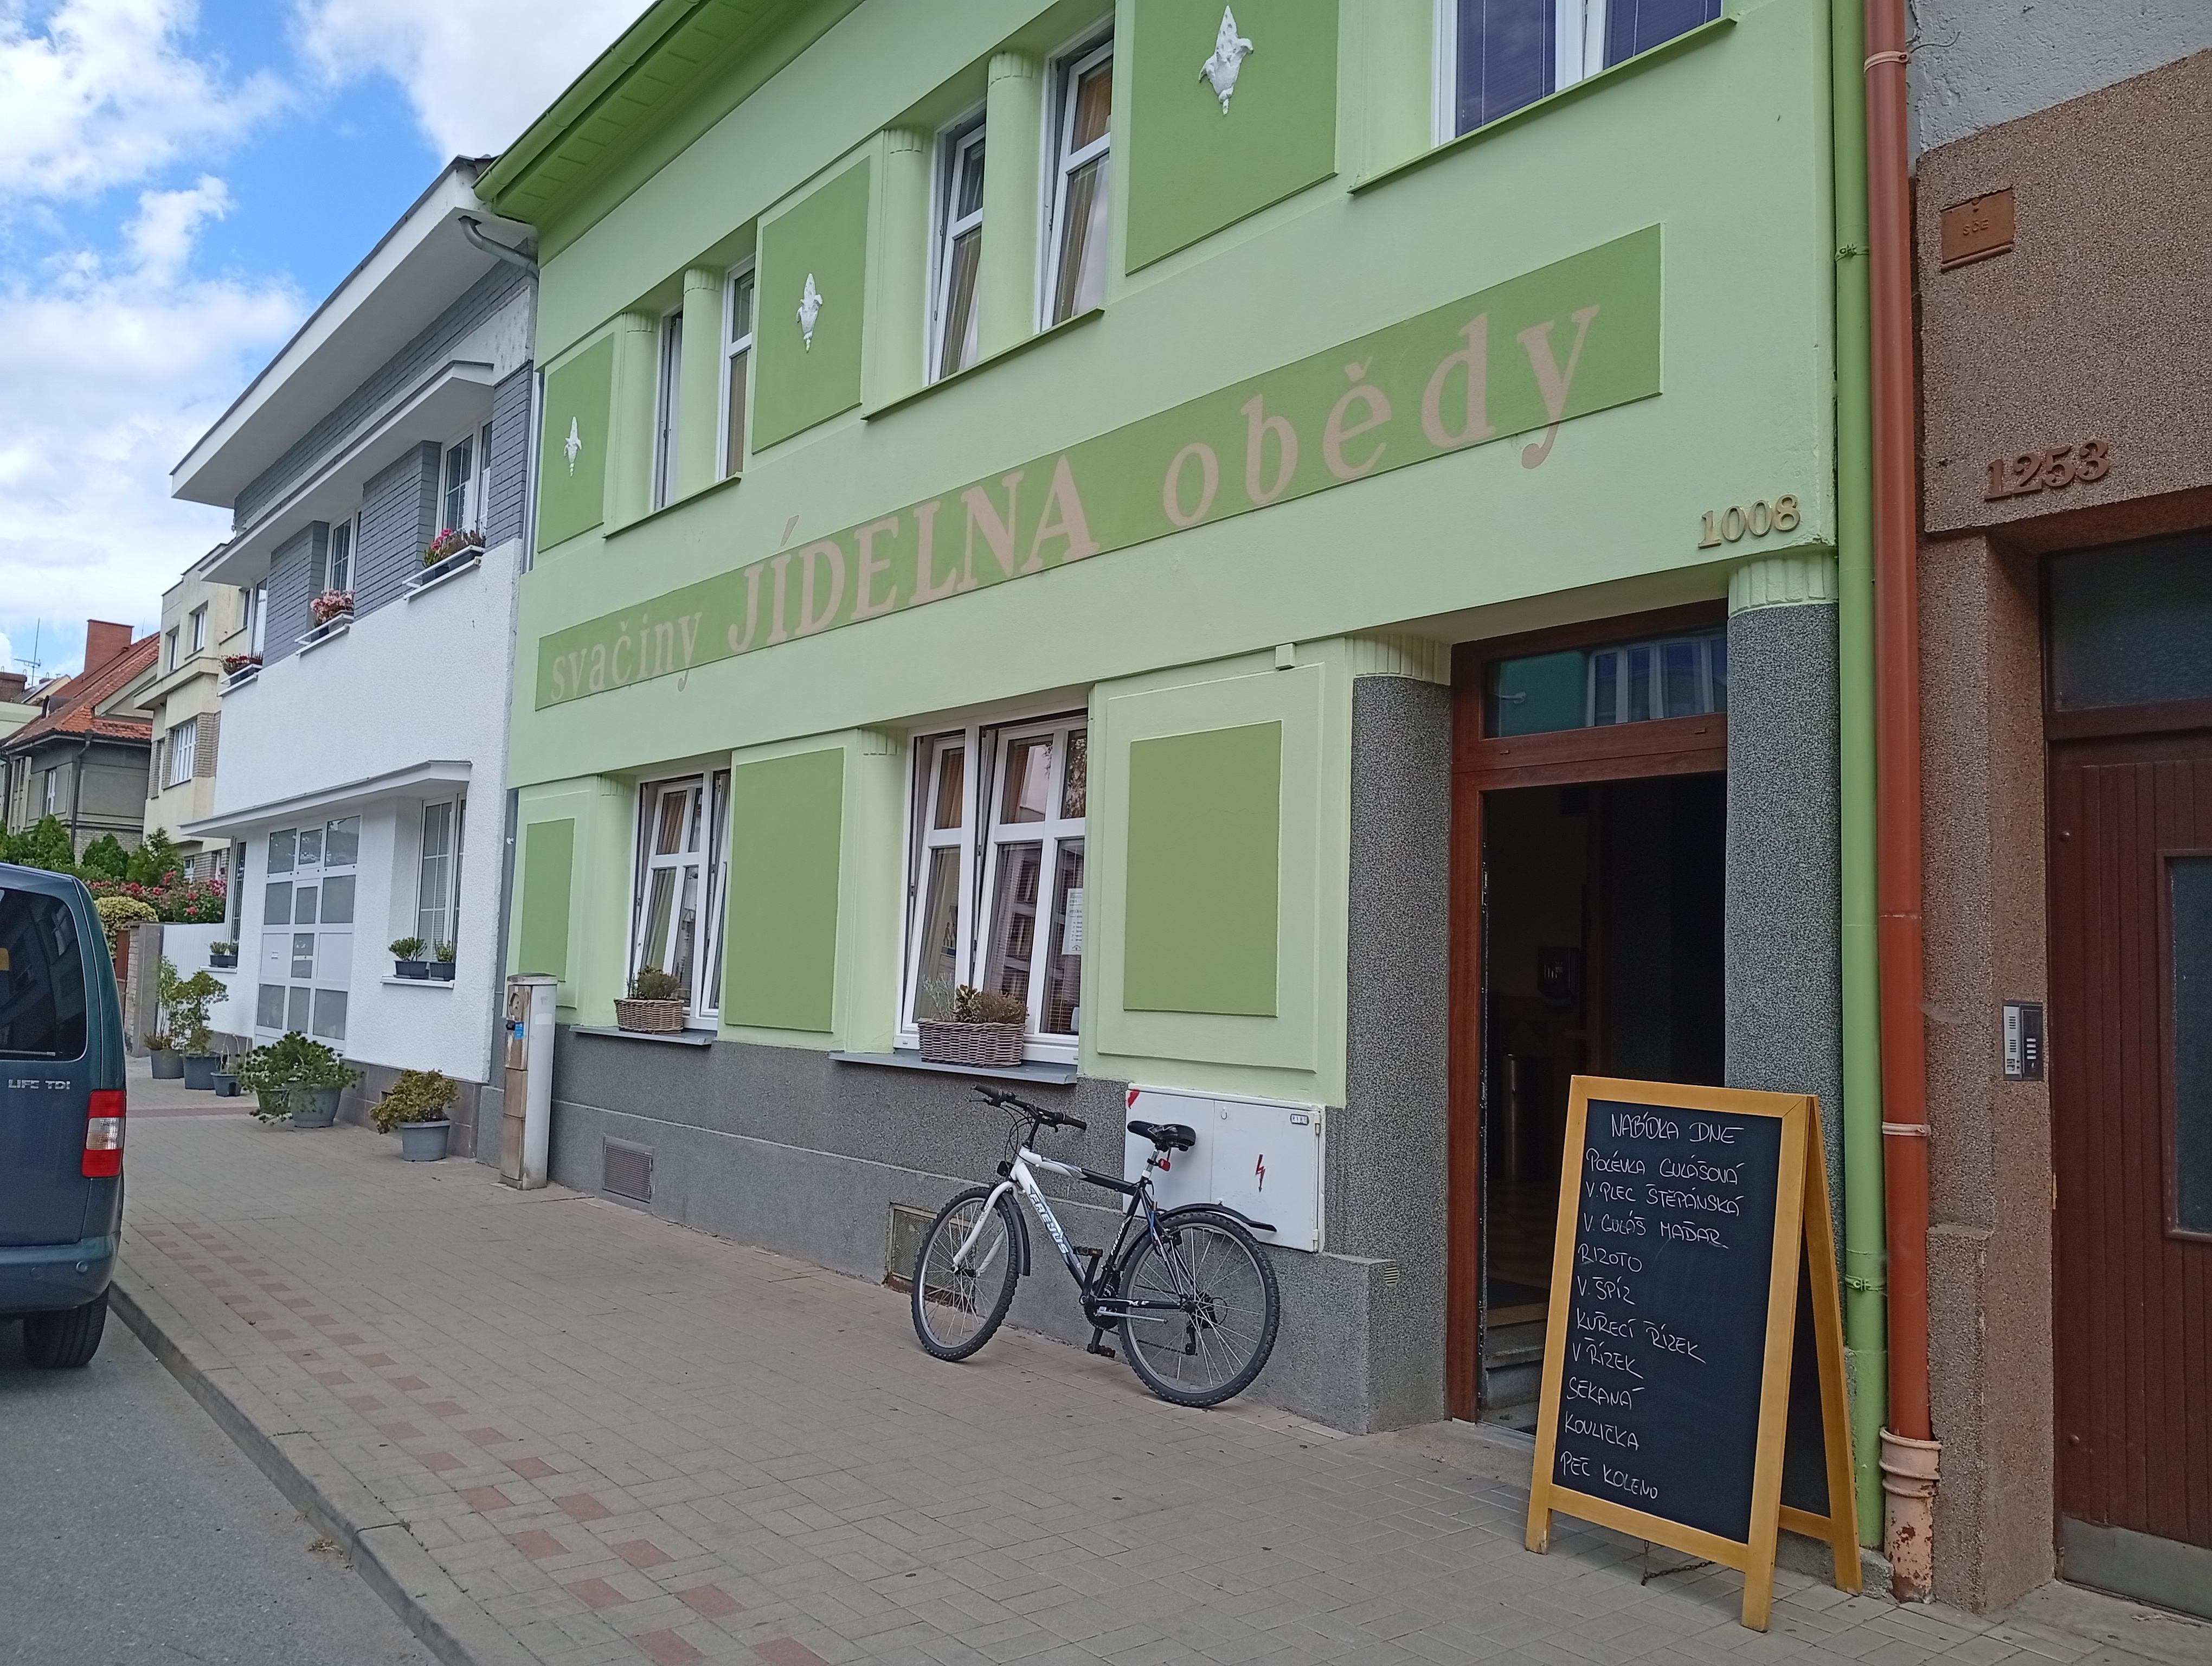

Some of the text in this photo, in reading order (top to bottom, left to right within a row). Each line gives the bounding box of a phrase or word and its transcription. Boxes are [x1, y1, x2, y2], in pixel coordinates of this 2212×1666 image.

[1985, 440, 2111, 500] 1253
[550, 304, 1600, 693] svačiny JÍDELNA obědy
[1698, 494, 1801, 549] 1008
[8, 1079, 70, 1090] LIFE TDI
[1611, 1112, 1744, 1144] NABÍDKA DNE
[1586, 1148, 1745, 1185] POLÉVKA GULÁŠOVÁ
[1645, 1184, 1744, 1216] ŠTĚPÁNSKÁ
[1030, 1194, 1069, 1253] FREJUS
[1601, 1210, 1646, 1235] GULÁŠ
[1578, 1243, 1642, 1272] RIZOTO
[1592, 1276, 1635, 1305] ŠPÍZ
[1577, 1308, 1706, 1364] KUŘECÍ ŘÍZEK
[1584, 1337, 1643, 1379] ŘÍZEK
[1566, 1376, 1645, 1410] SEKANÁ
[1603, 1464, 1658, 1499] KOLENO
